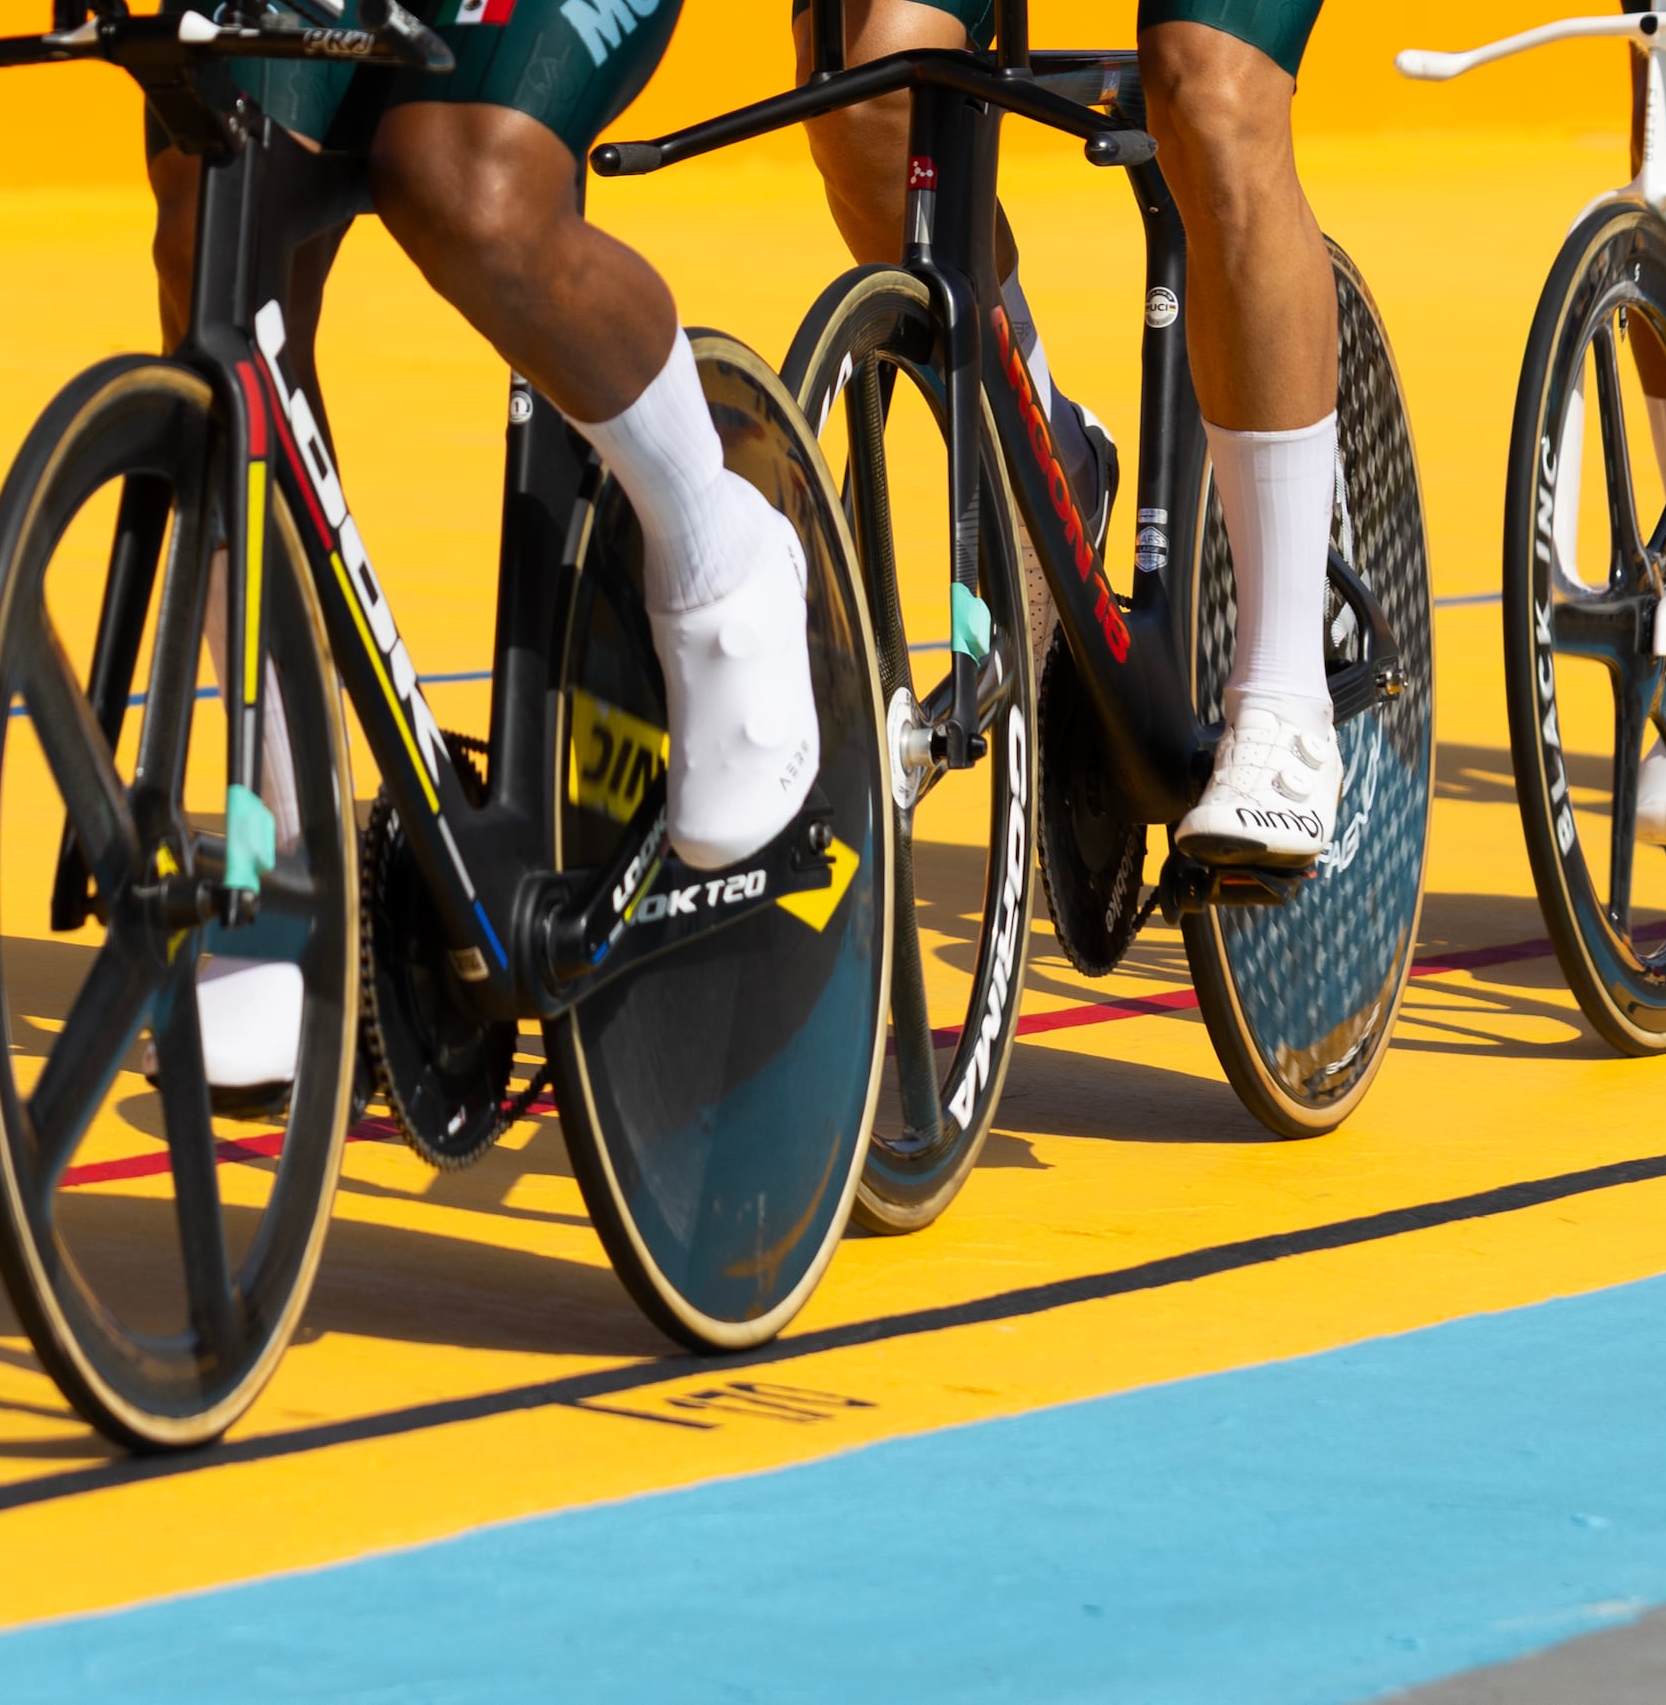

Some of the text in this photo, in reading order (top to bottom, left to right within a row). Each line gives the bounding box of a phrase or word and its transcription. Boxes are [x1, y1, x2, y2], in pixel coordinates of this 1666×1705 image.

[989, 303, 1131, 665] ARGON 18
[1149, 303, 1168, 312] UCI
[255, 299, 451, 787] LOOK
[1534, 435, 1573, 857] BLACK INC
[704, 868, 767, 908] T20
[947, 703, 1027, 1130] CORIMA
[1235, 807, 1325, 844] nimbl
